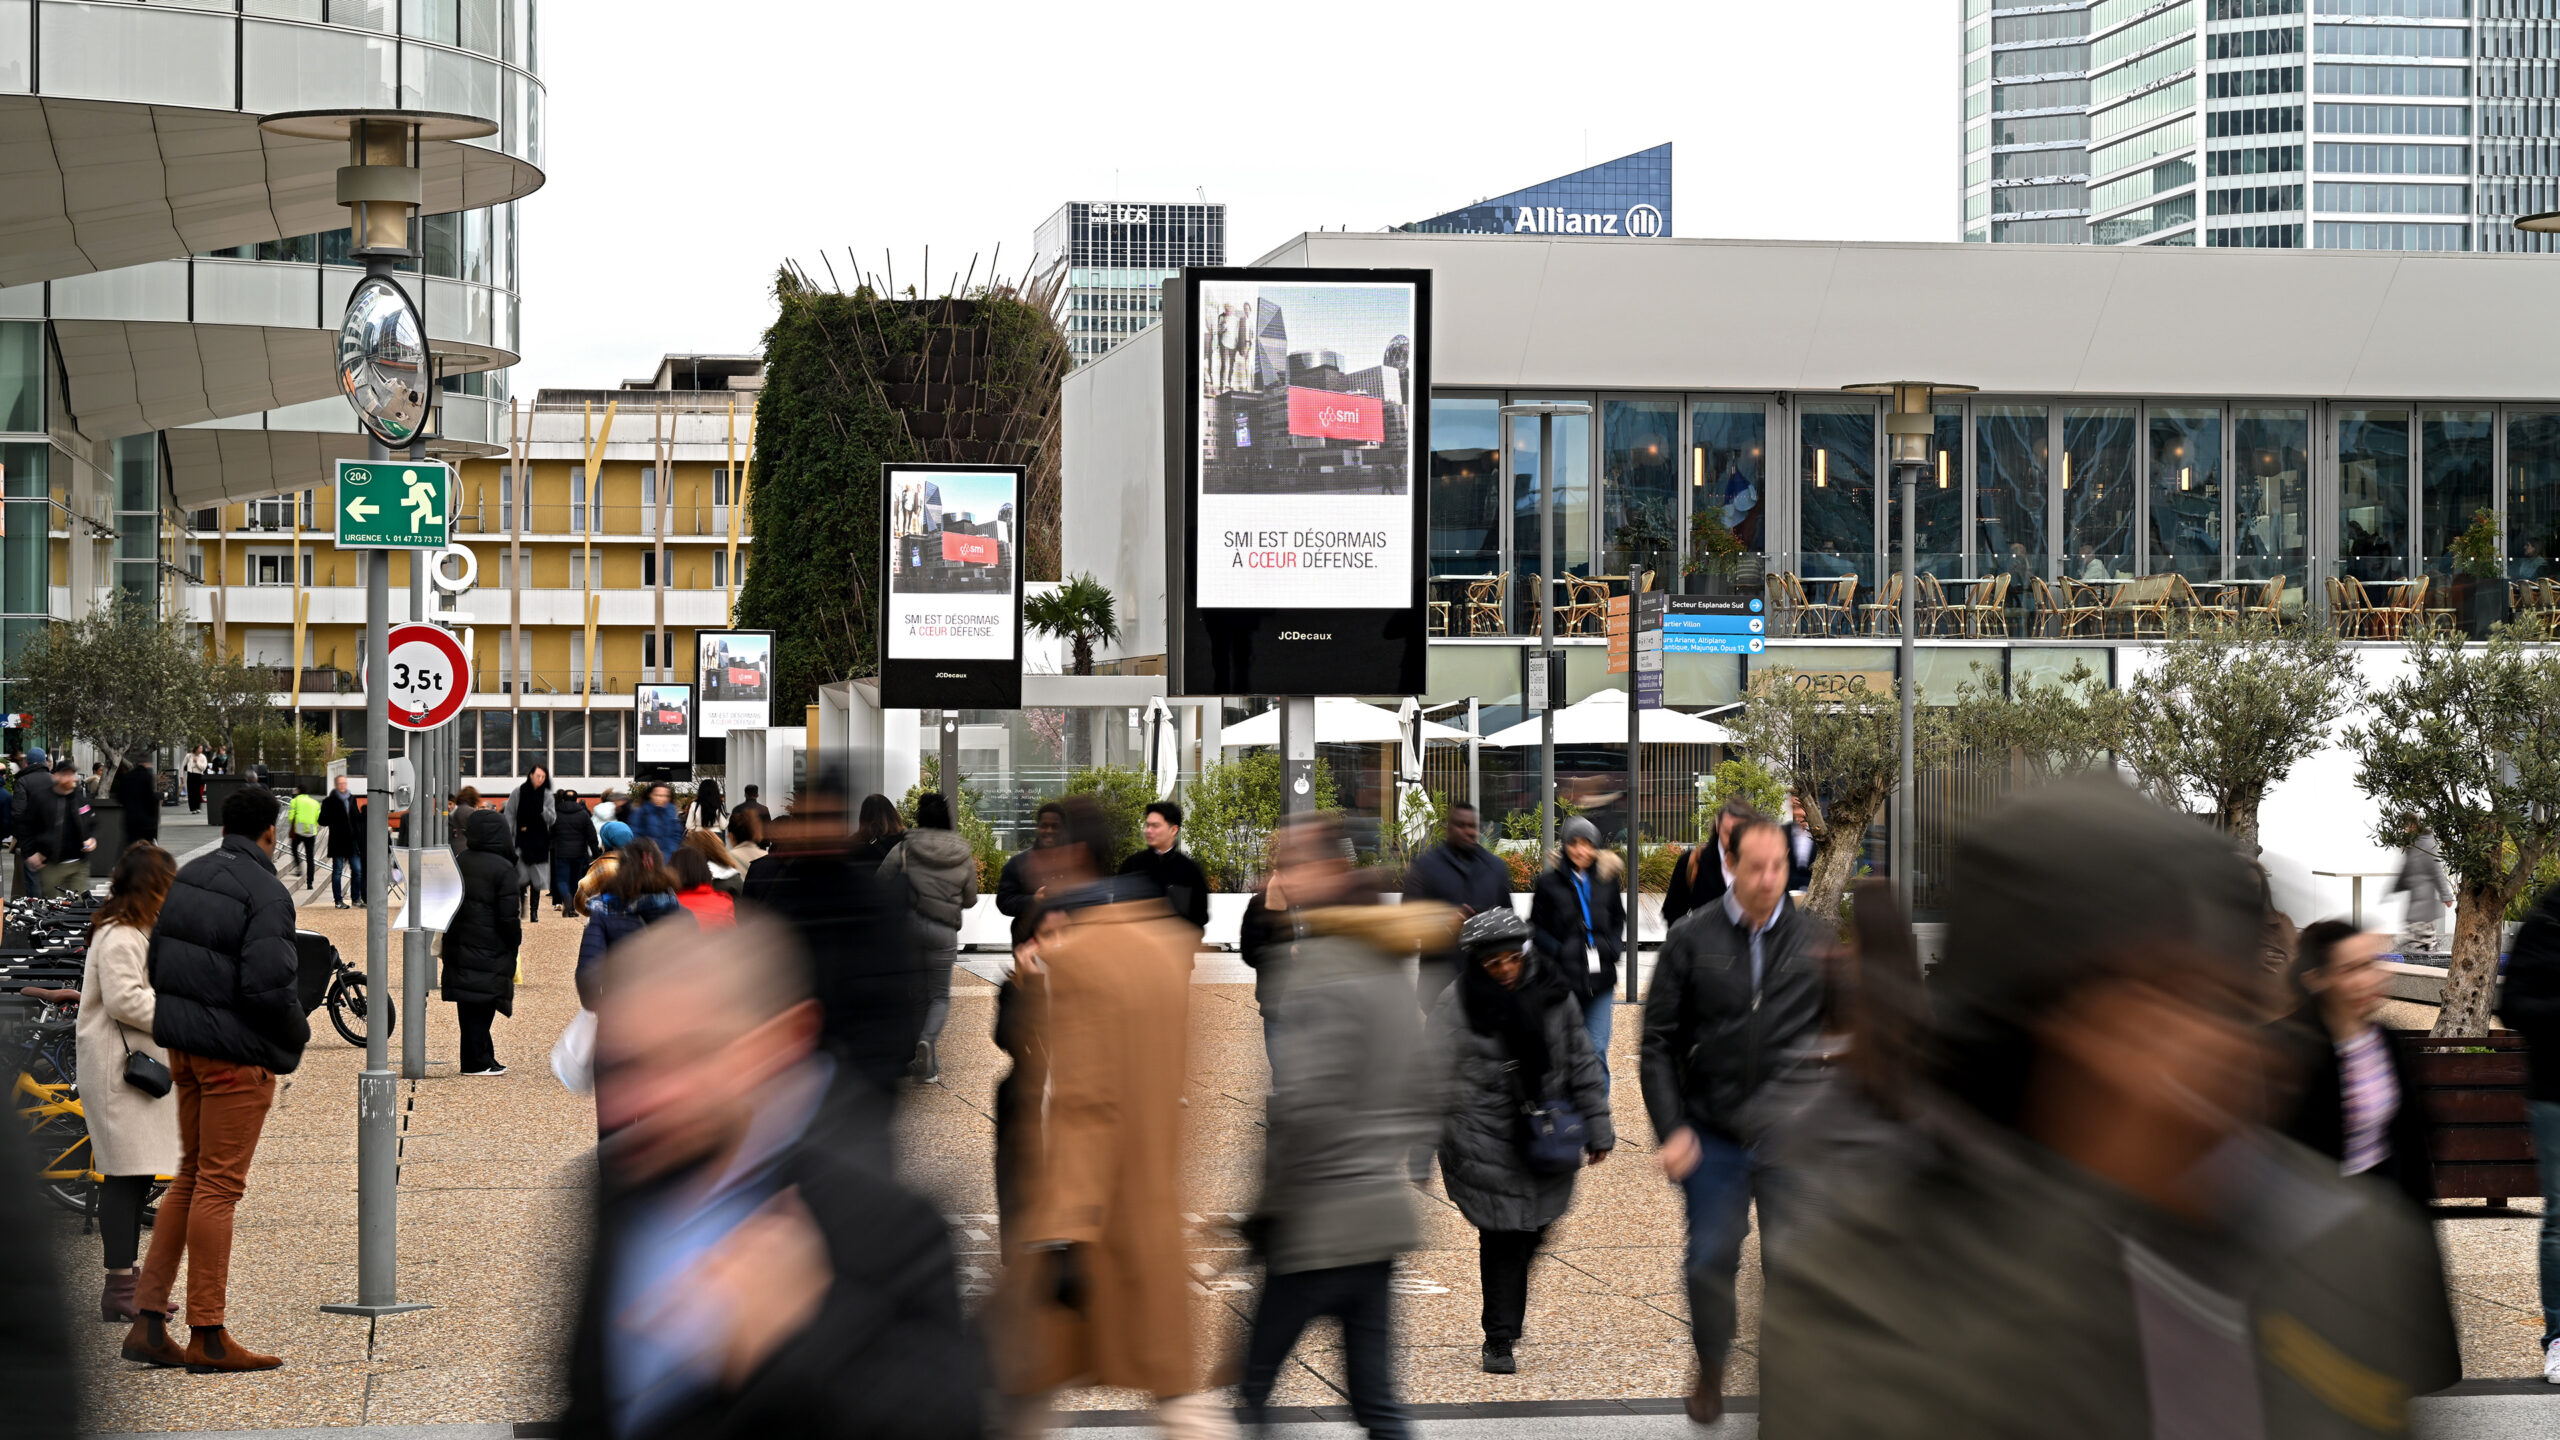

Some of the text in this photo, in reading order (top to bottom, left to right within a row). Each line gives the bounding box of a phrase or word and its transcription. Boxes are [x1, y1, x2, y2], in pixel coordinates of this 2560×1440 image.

[1514, 206, 1618, 234] Allianz
[1336, 408, 1360, 424] smi
[349, 472, 367, 481] 204
[345, 534, 382, 542] URGENCE
[414, 535, 423, 543] 73
[1224, 528, 1387, 548] SMI EST DÉSORMAIS
[1232, 549, 1378, 569] À CŒUR DÉFENSE.
[1698, 601, 1730, 610] Esplanade
[904, 612, 1000, 625] SMI EST DÉSORMAIS
[1683, 620, 1701, 628] Villon
[1278, 631, 1332, 641] JCDecaux
[392, 663, 443, 693] 3,5t
